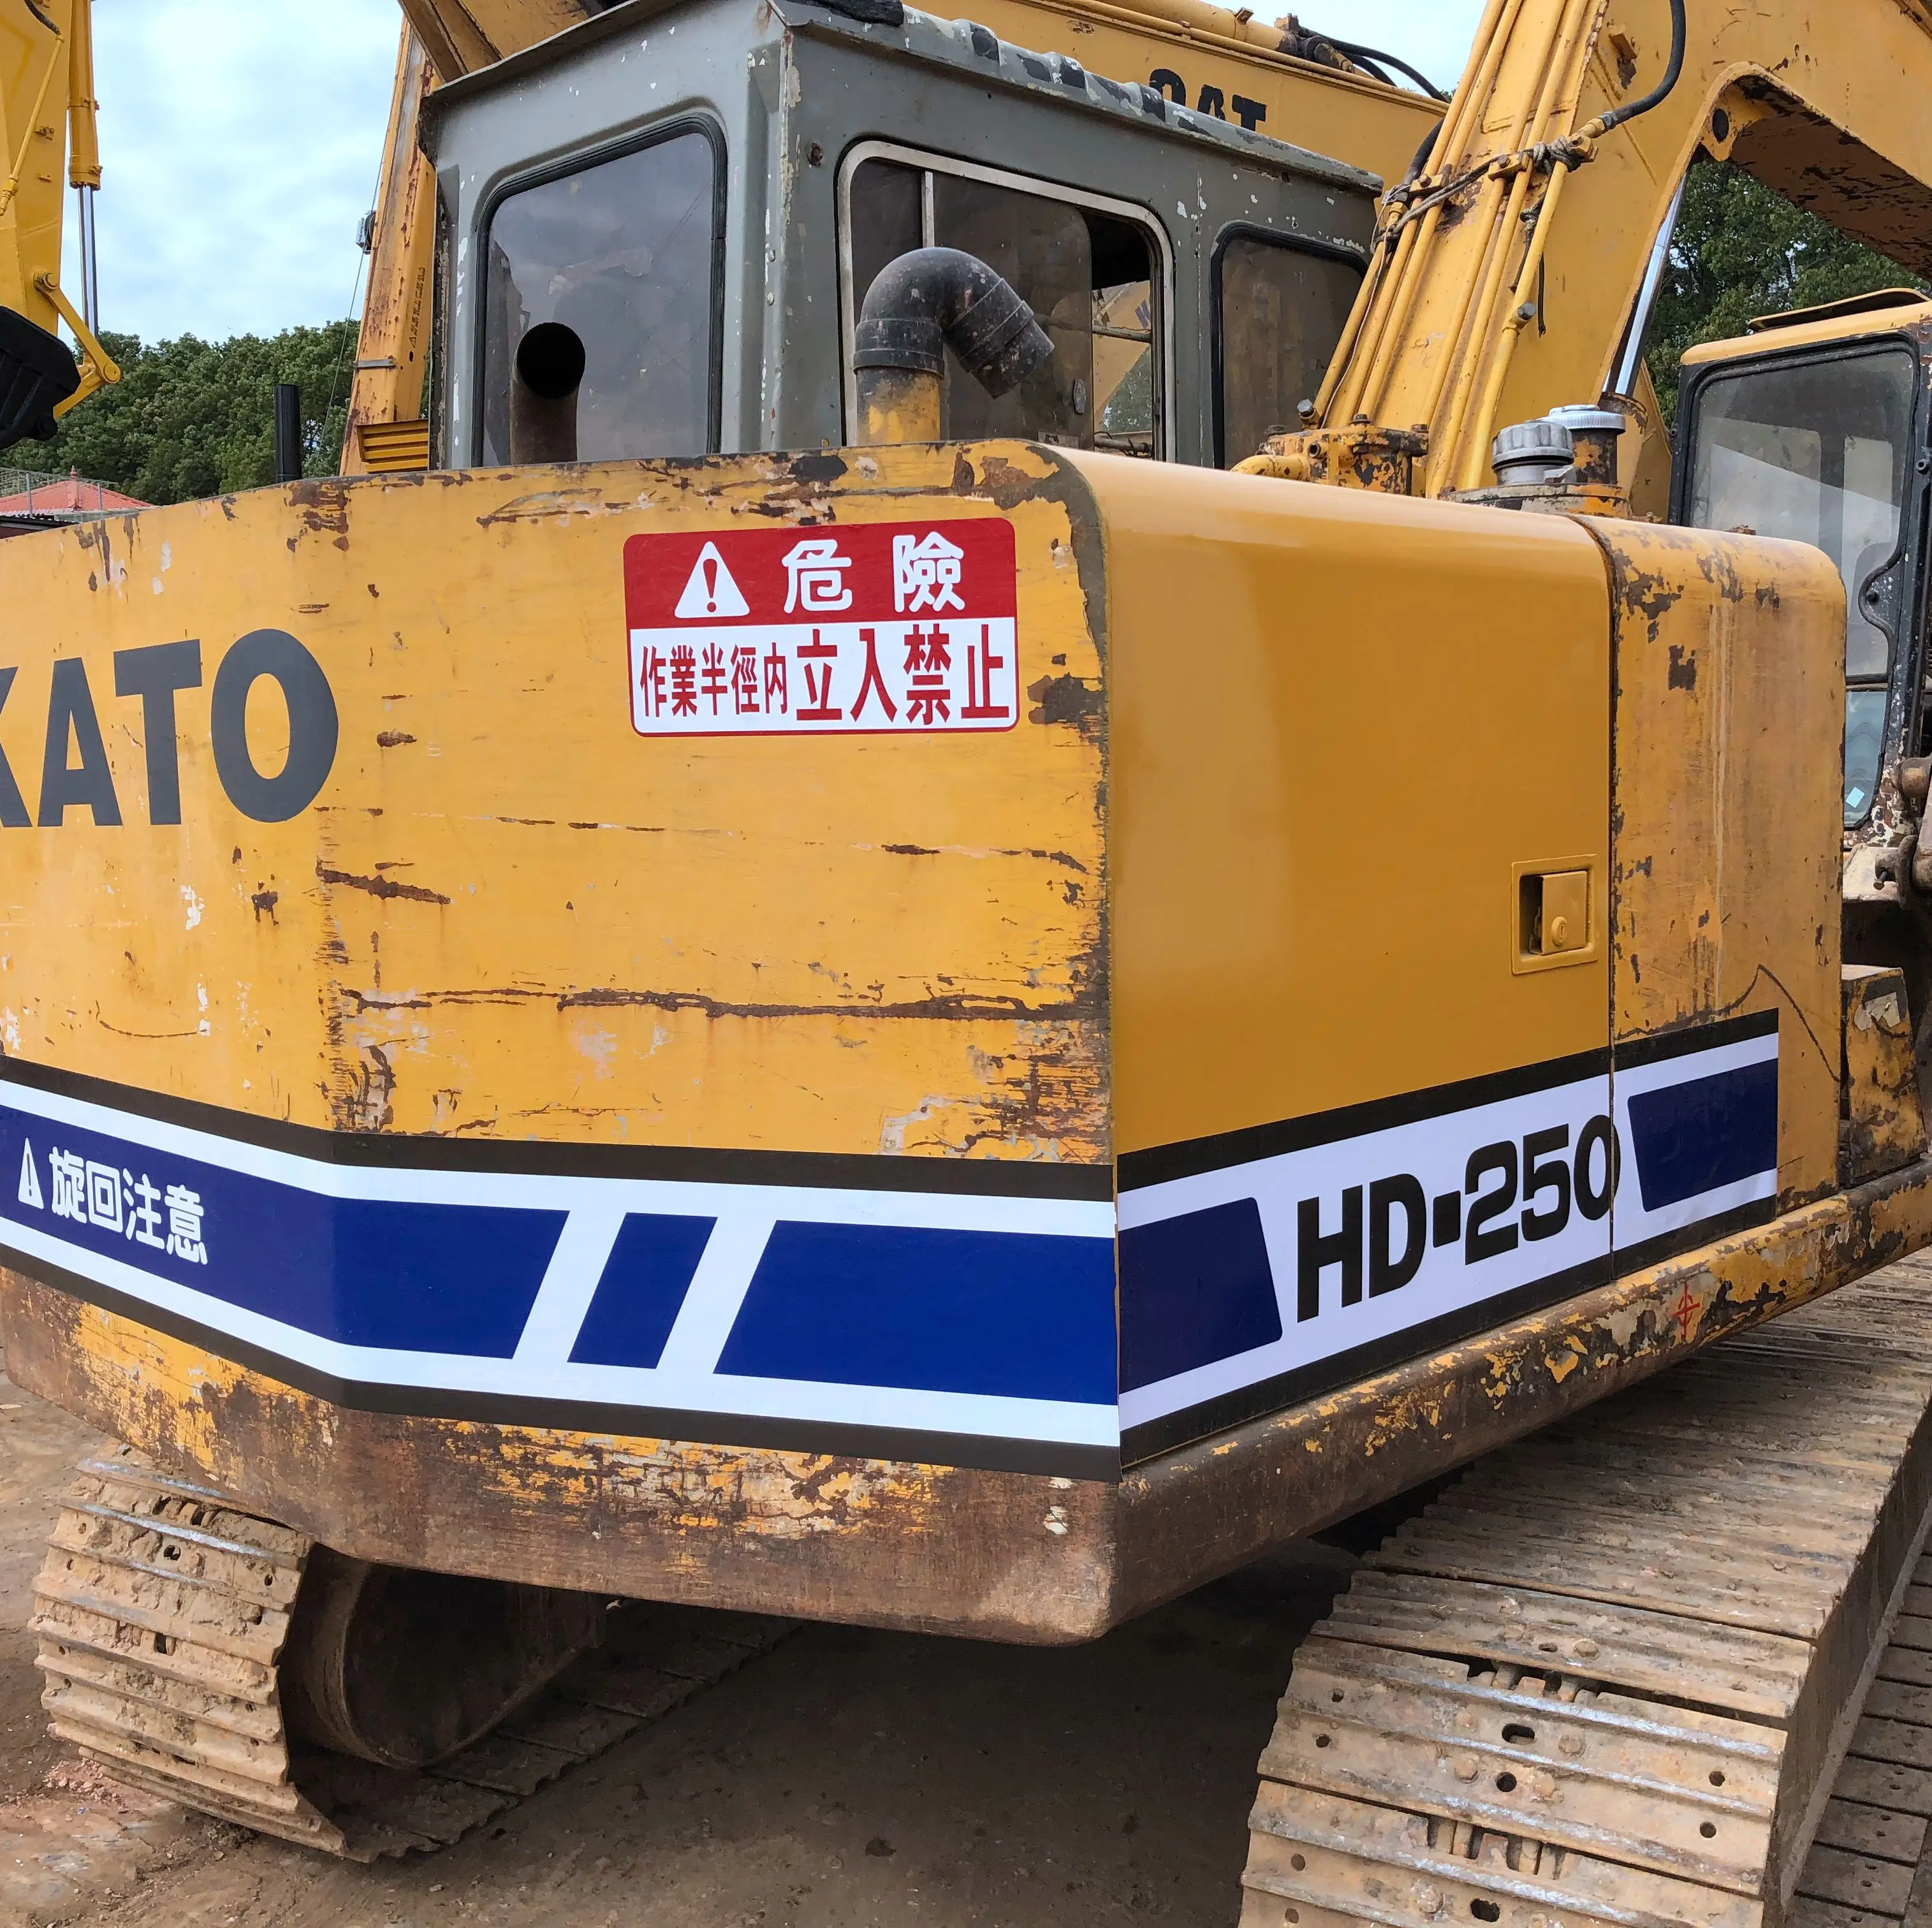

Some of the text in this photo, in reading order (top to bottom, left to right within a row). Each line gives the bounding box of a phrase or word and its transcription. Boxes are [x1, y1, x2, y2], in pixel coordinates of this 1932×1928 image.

[48, 1146, 208, 1265] 旋回注意
[1297, 1114, 1621, 1323] HD-250
